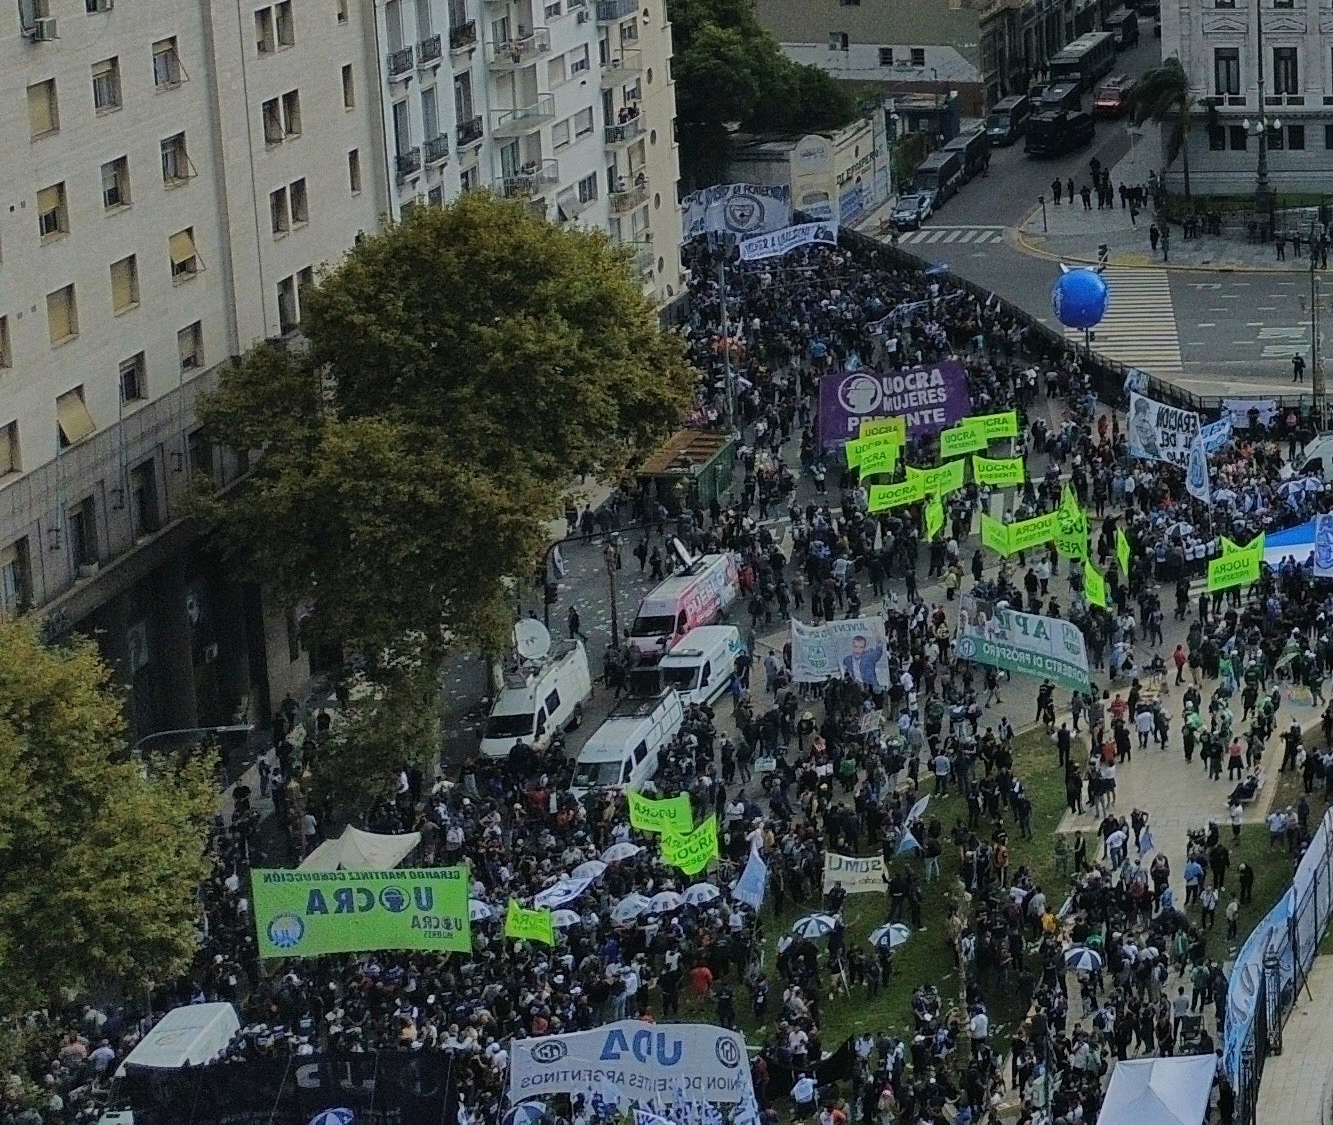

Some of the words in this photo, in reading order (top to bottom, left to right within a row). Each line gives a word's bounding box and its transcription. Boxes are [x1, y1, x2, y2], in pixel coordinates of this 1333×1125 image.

[883, 369, 944, 394] UOCRA
[883, 386, 947, 412] MUJERES
[865, 426, 898, 437] UOCRA
[945, 431, 976, 444] UOCRA
[878, 485, 917, 500] UOCRA
